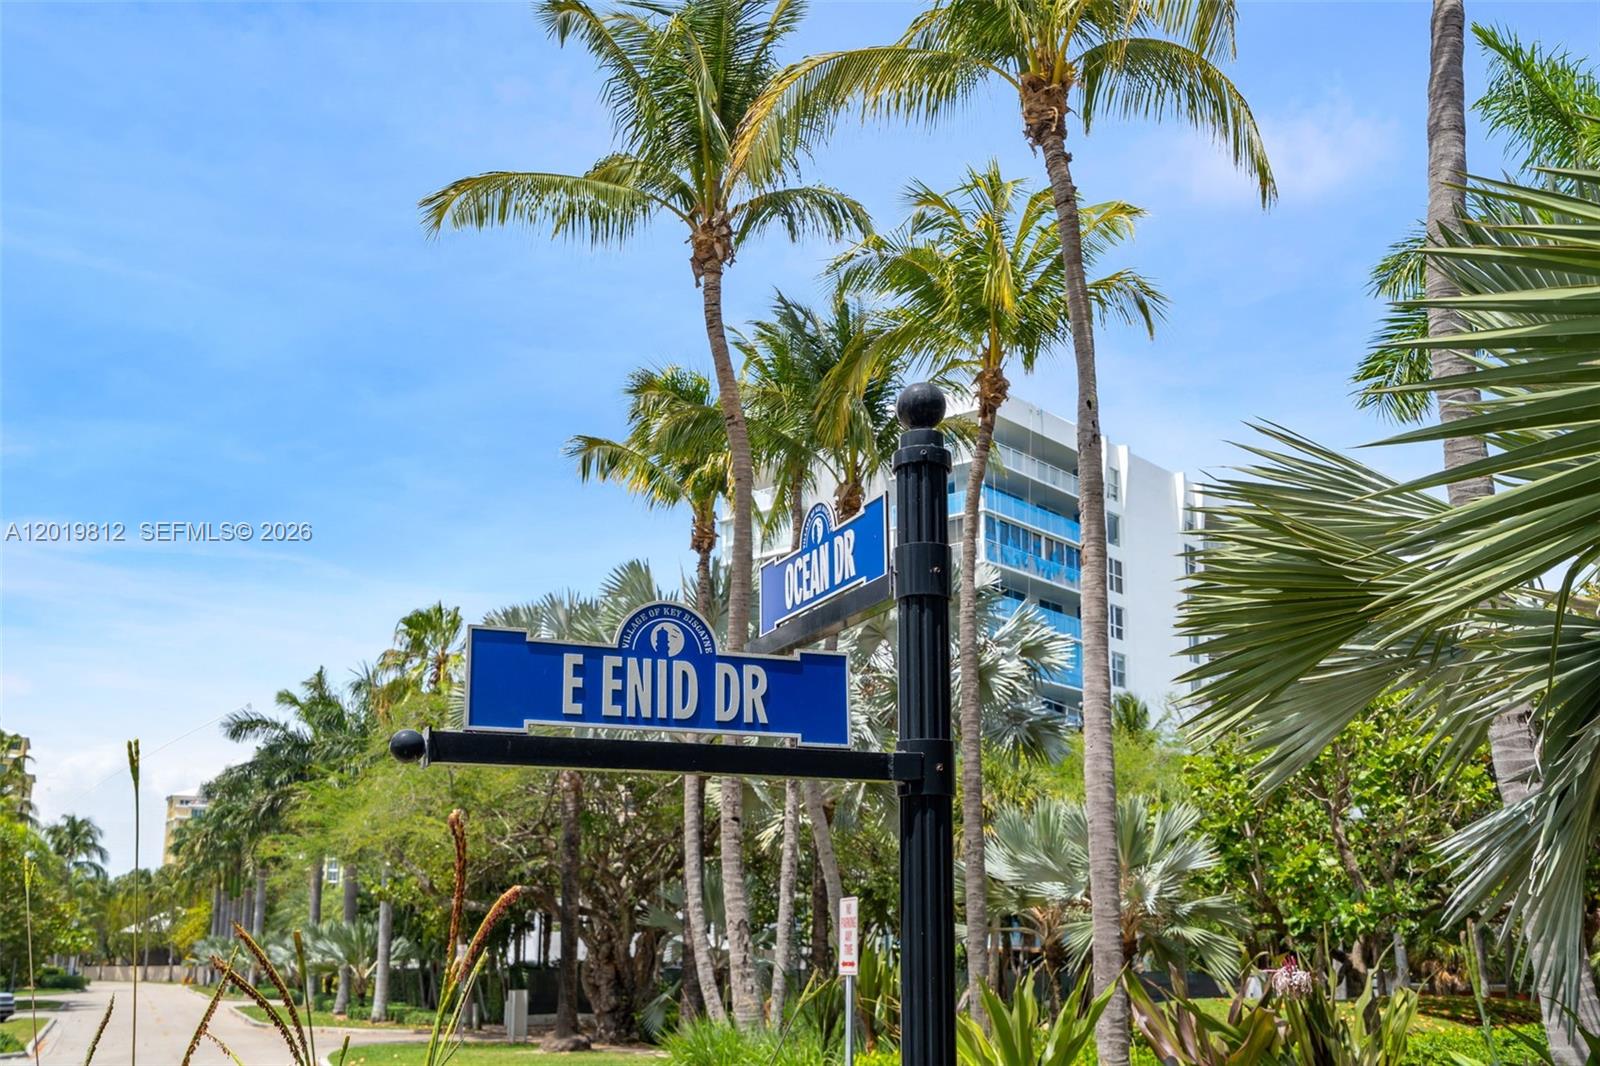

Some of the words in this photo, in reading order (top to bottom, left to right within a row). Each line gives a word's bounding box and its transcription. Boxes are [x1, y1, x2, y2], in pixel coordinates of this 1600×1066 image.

[784, 541, 830, 610] OCEAN
[833, 528, 856, 586] DR
[621, 613, 648, 649] VILLAGE
[648, 607, 661, 617] OF
[663, 607, 682, 617] KEY
[682, 613, 713, 654] BISCAYNE
[562, 653, 584, 715] E
[602, 655, 699, 720] ENID
[715, 662, 768, 724] DR
